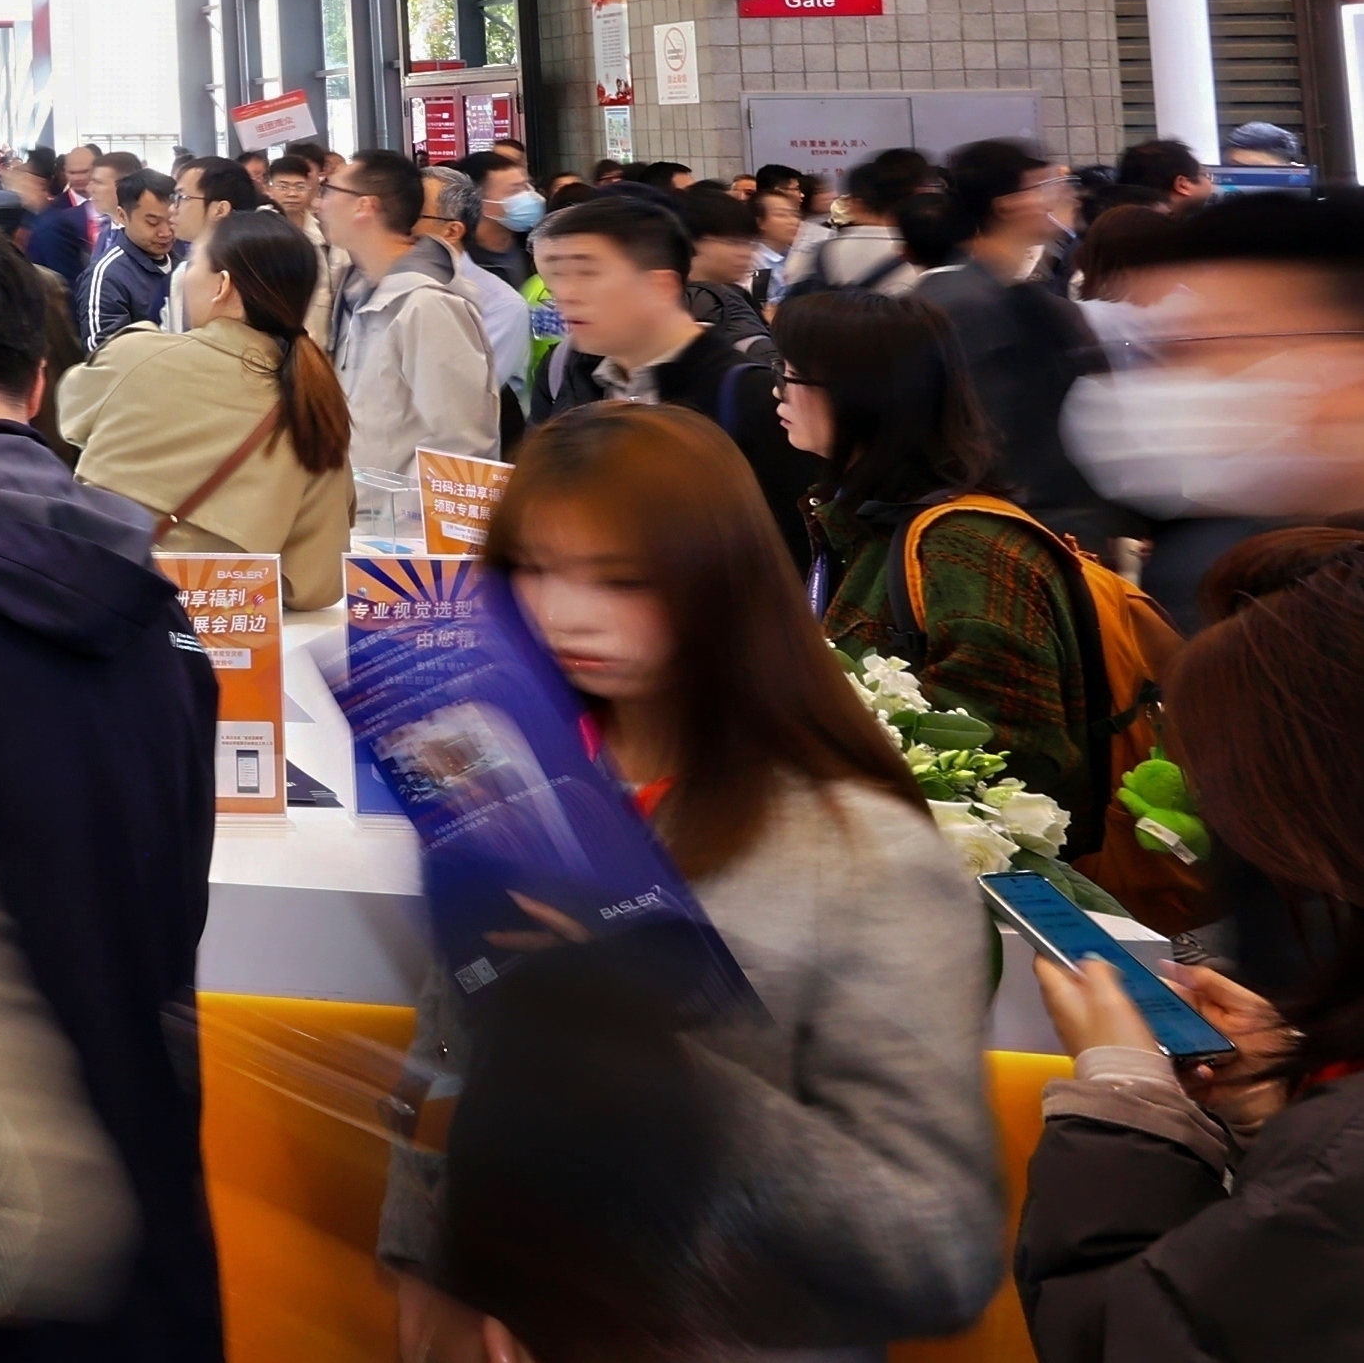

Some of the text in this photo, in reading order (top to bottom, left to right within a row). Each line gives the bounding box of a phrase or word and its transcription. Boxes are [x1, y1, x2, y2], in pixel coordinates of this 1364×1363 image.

[493, 474, 510, 483] BAS
[431, 479, 506, 503] 扫码注册享福
[434, 499, 492, 521] 领取专属展
[217, 570, 264, 580] BASLER
[352, 600, 473, 621] 专业视觉选型
[186, 615, 267, 635] 展会周边
[416, 630, 477, 649] 由您精
[599, 891, 658, 920] BASLER
